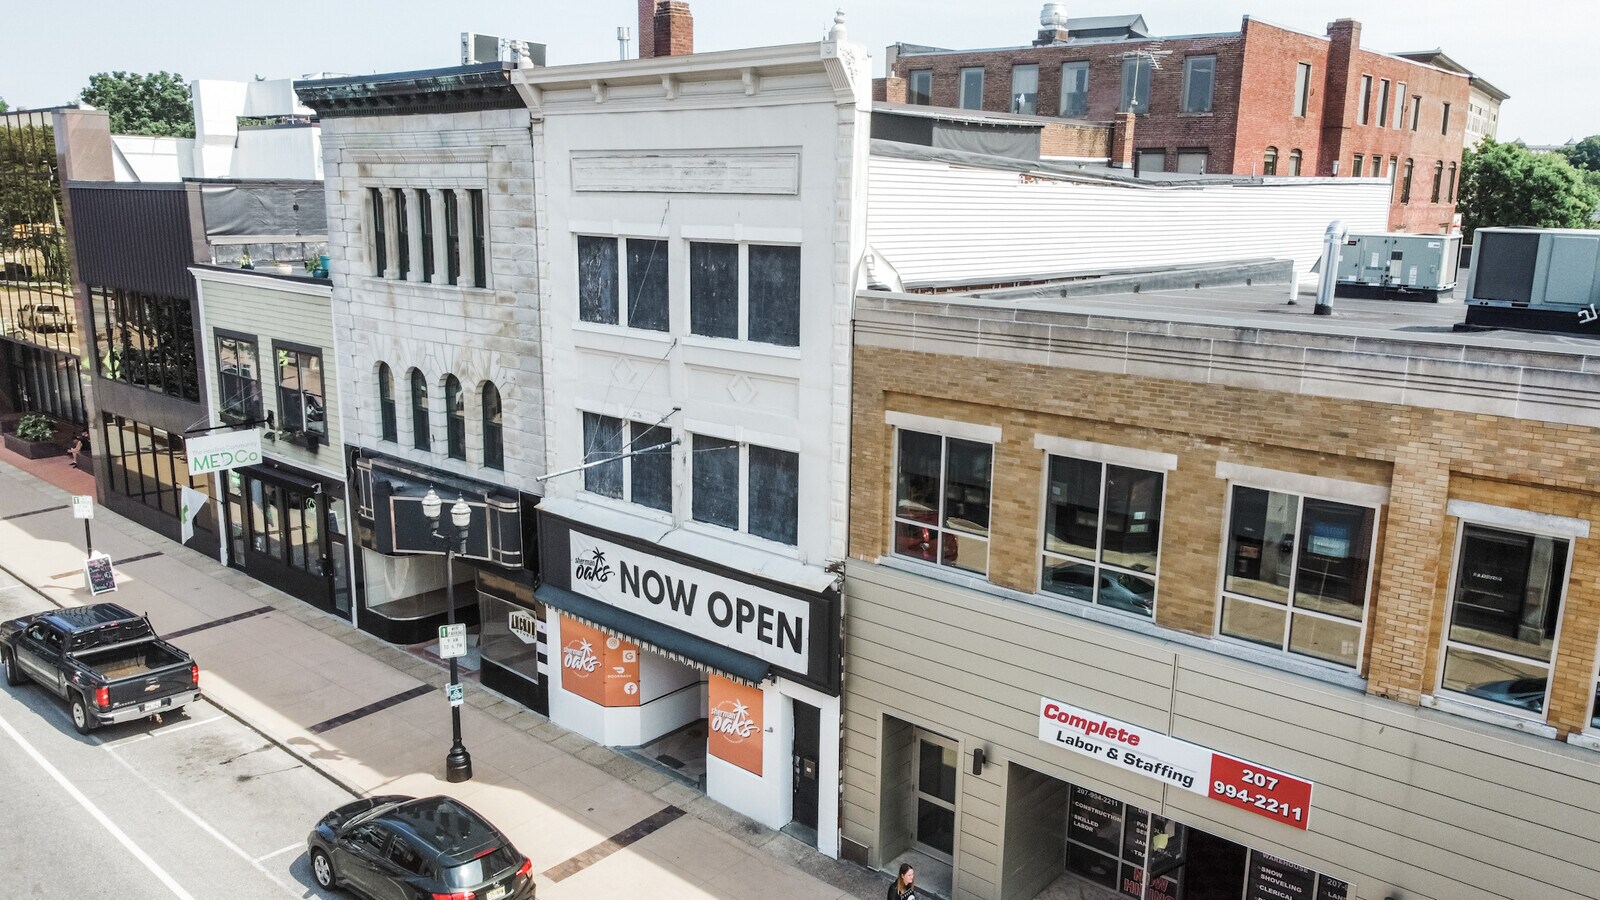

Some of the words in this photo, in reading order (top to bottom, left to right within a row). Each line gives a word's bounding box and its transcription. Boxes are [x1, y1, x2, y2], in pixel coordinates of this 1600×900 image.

[193, 449, 258, 472] MEDCo
[575, 556, 596, 567] sherman
[575, 564, 616, 583] oaks
[619, 560, 699, 617] NOW
[707, 590, 803, 655] OPEN
[564, 653, 602, 673] oaks
[711, 706, 737, 720] sherman
[711, 715, 761, 738] oaks
[1043, 703, 1141, 747] Complete
[1056, 729, 1103, 755] Labor
[1106, 747, 1119, 761] &
[1123, 751, 1195, 789] Staffing
[1241, 768, 1279, 791] 207
[1074, 801, 1122, 823] CONSTRUCTION
[1213, 780, 1303, 822] 994-2211
[1073, 814, 1099, 828] SKILLED
[1073, 821, 1095, 833] LABOR
[1260, 866, 1284, 878] SNOW
[1262, 852, 1309, 874] WAREHOUSE
[1260, 873, 1303, 893] SHOVELING
